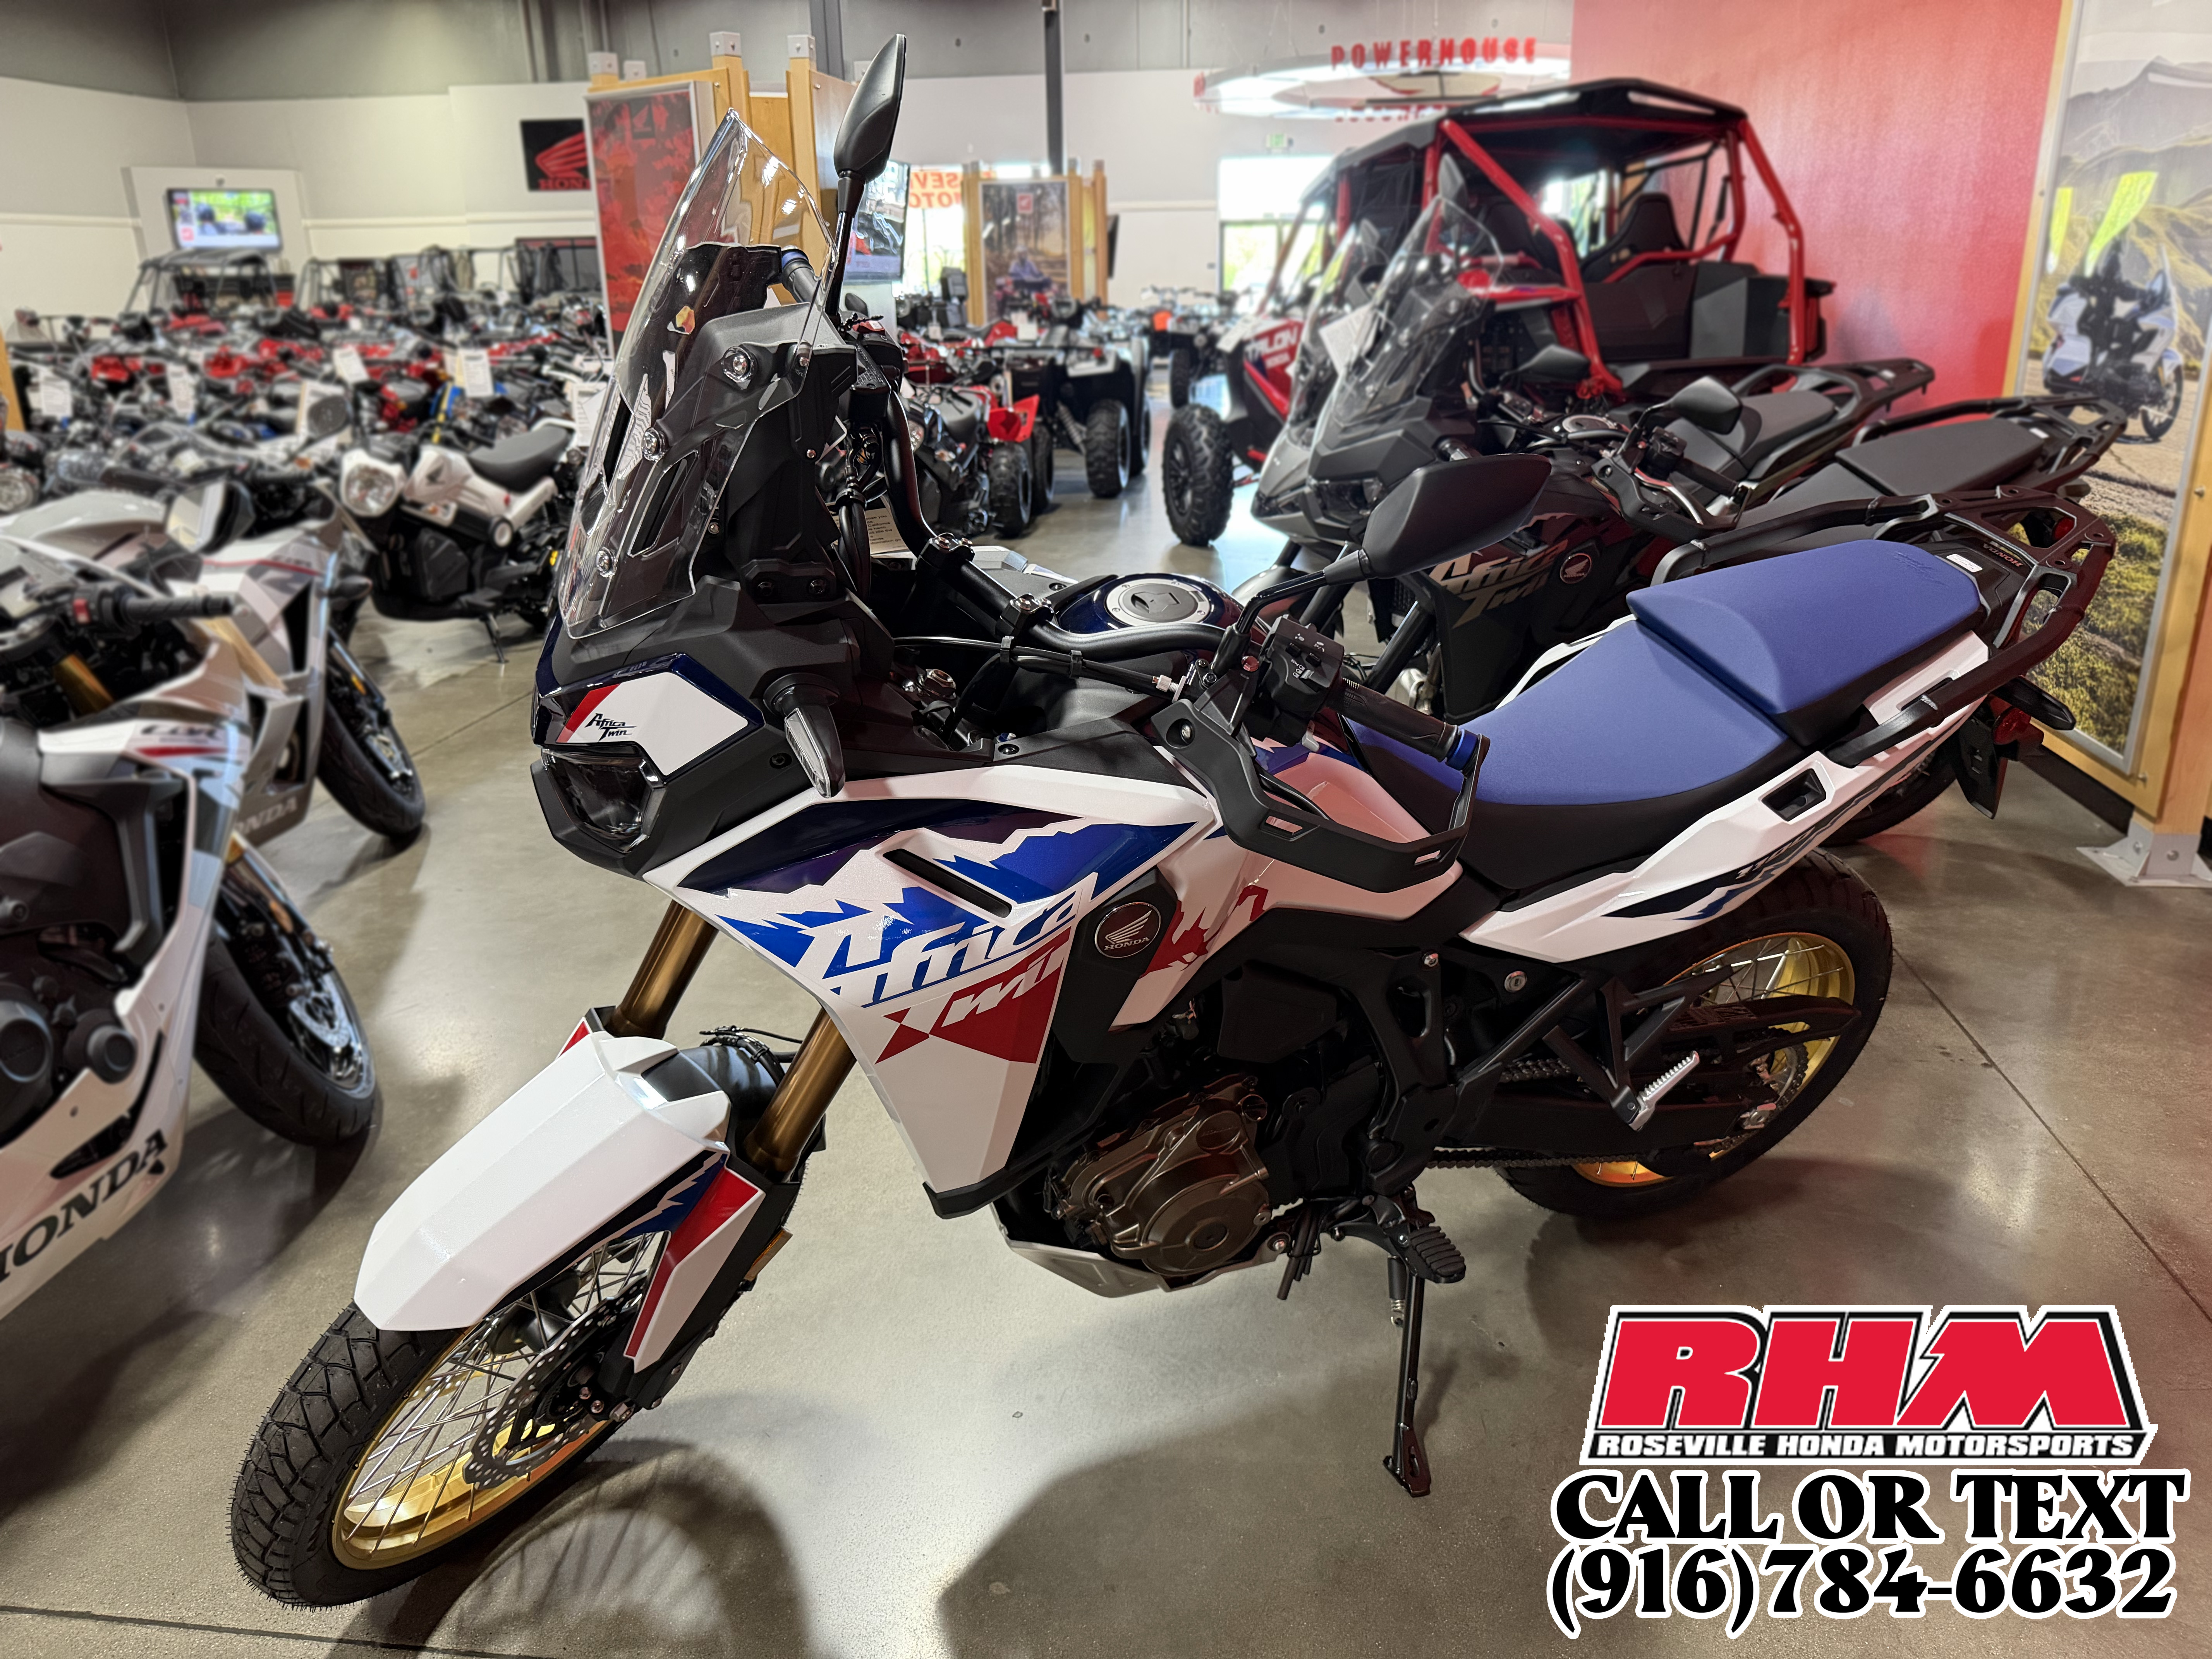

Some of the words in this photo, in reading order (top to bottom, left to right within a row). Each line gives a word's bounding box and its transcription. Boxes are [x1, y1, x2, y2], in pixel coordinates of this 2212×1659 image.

[1331, 37, 1537, 70] POWERHOUSE
[1983, 543, 2023, 567] HONDA
[584, 713, 637, 730] Africa
[598, 726, 632, 742] Twin
[1104, 937, 1150, 950] HONDA
